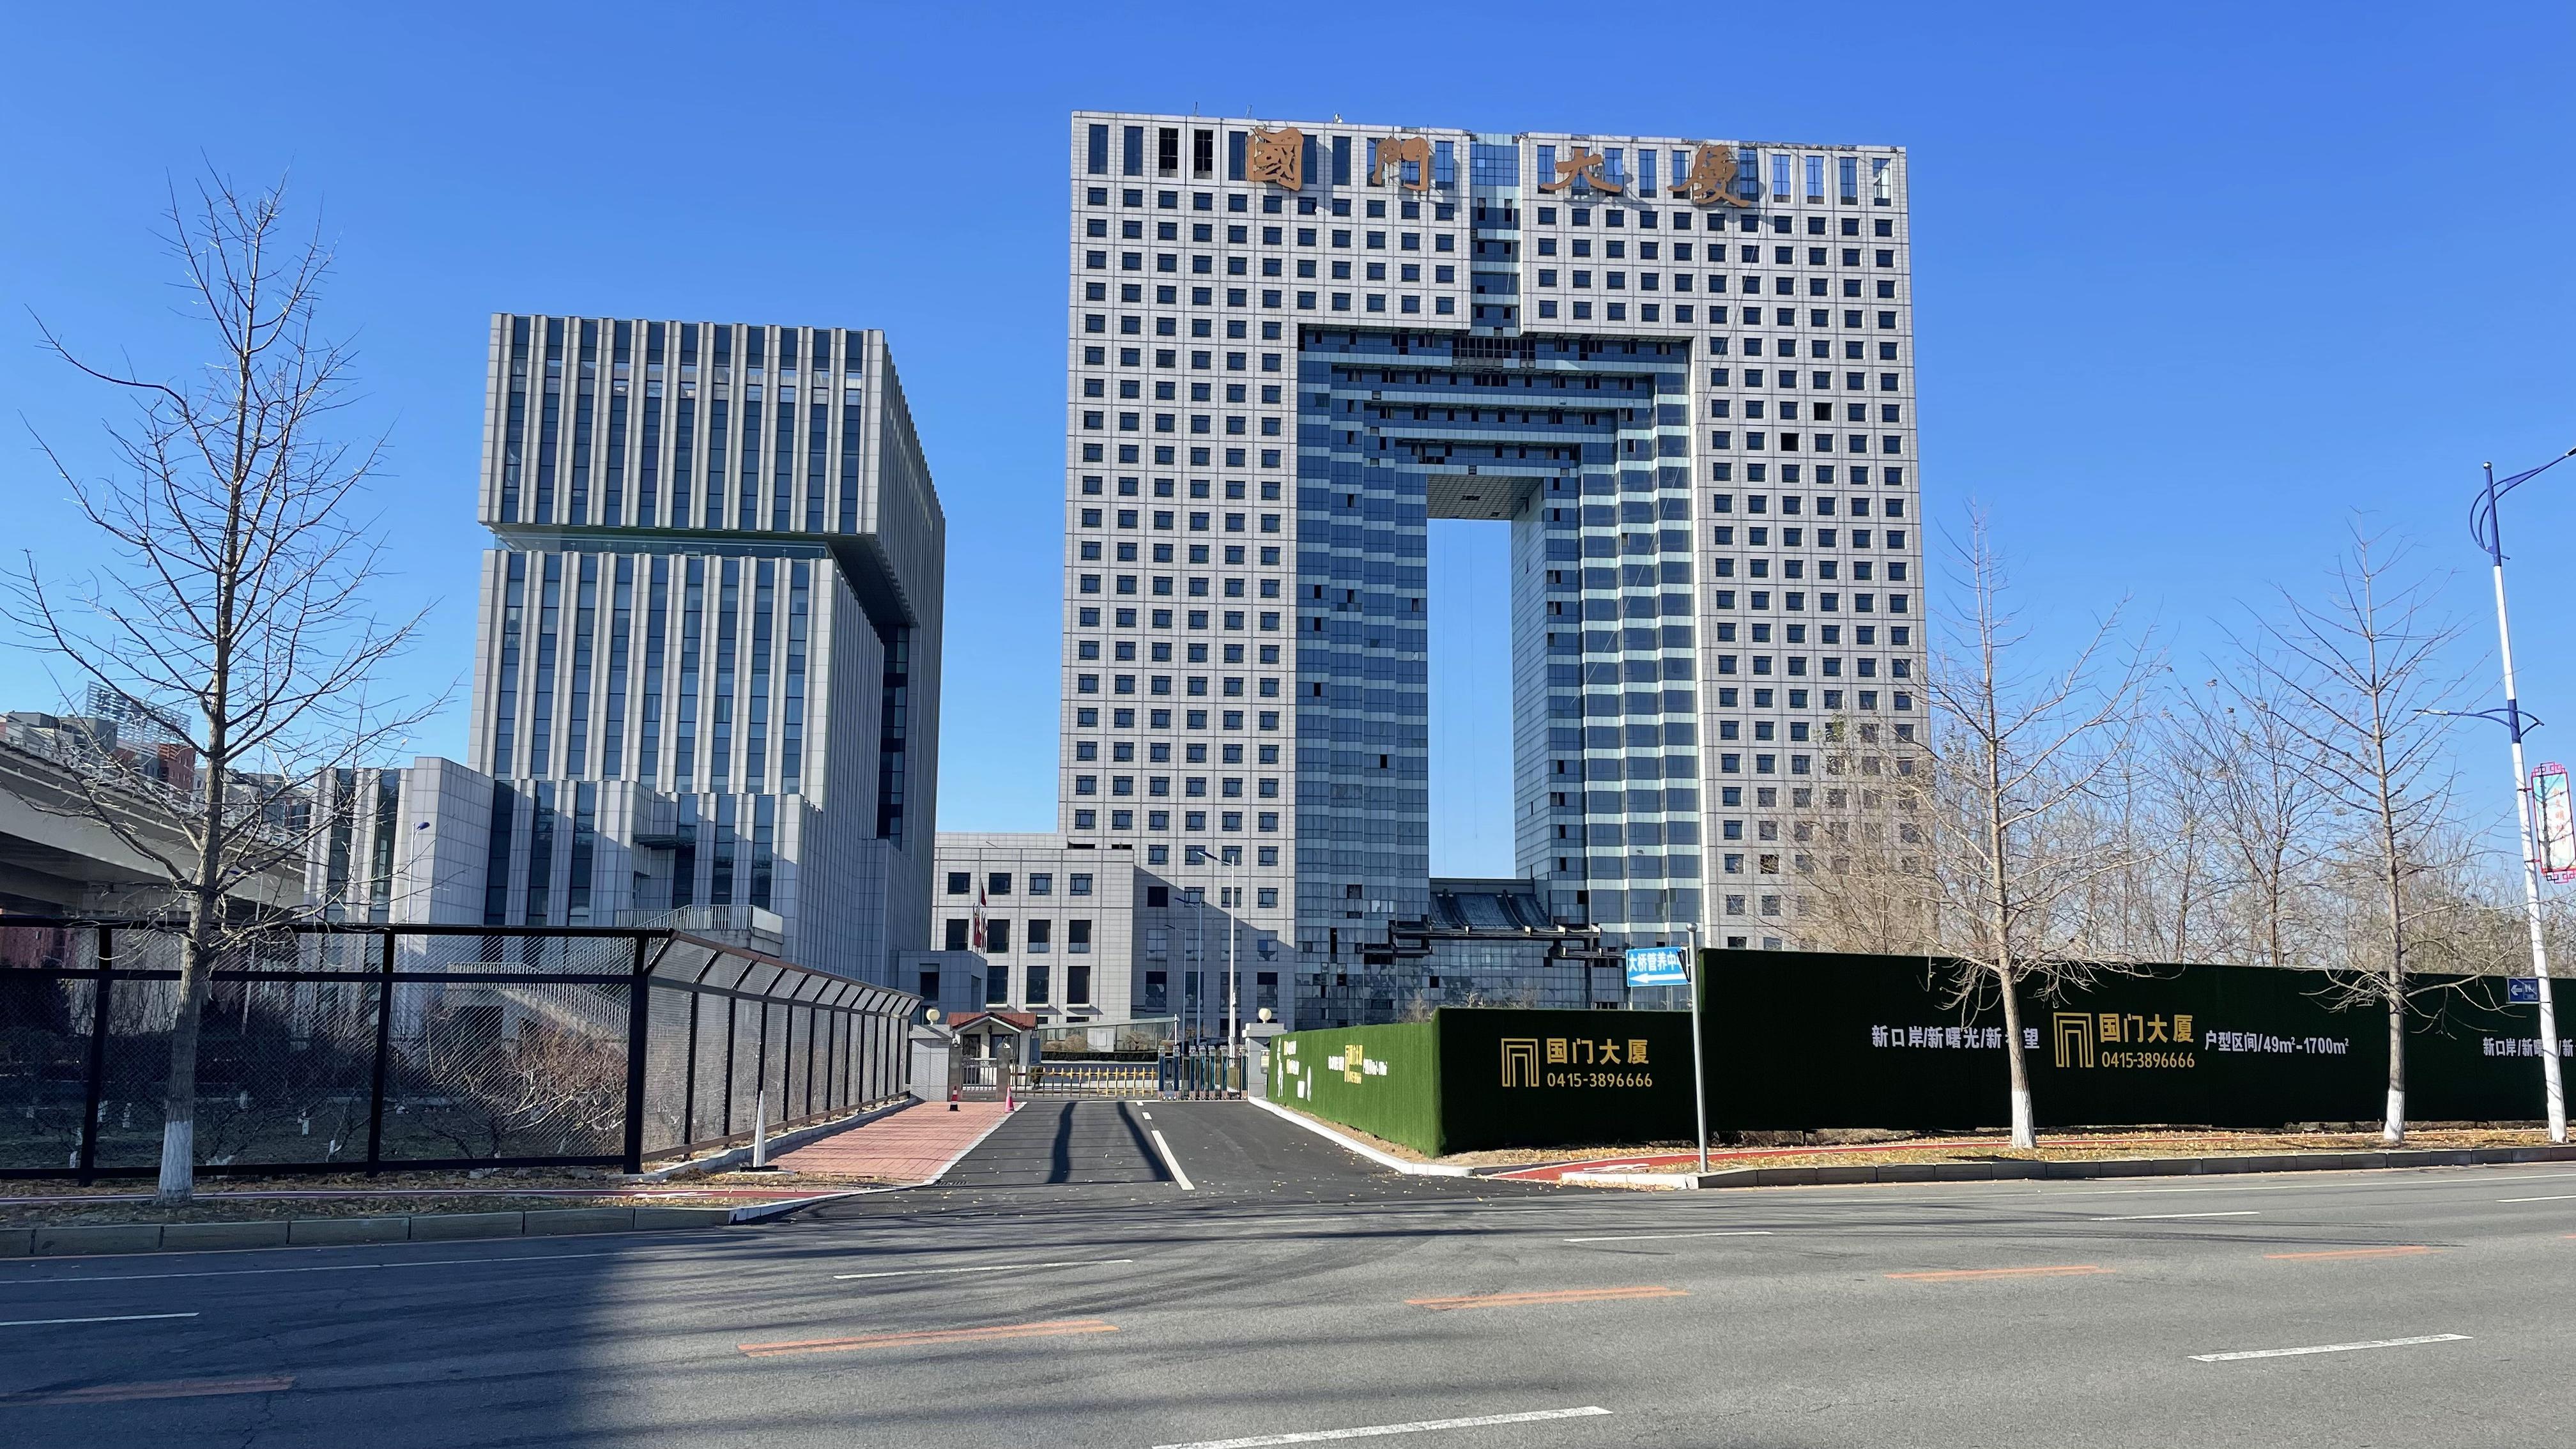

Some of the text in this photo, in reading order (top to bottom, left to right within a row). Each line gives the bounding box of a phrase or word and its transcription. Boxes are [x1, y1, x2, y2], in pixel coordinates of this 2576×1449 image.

[1871, 1025, 2040, 1049] 新口岸/新曙光/新望
[2099, 1013, 2194, 1043] 国门大厦
[1547, 1038, 1649, 1064] 国门大厦
[2101, 1052, 2195, 1068] 0415-3896666
[1547, 1073, 1653, 1087] 0415-3896666
